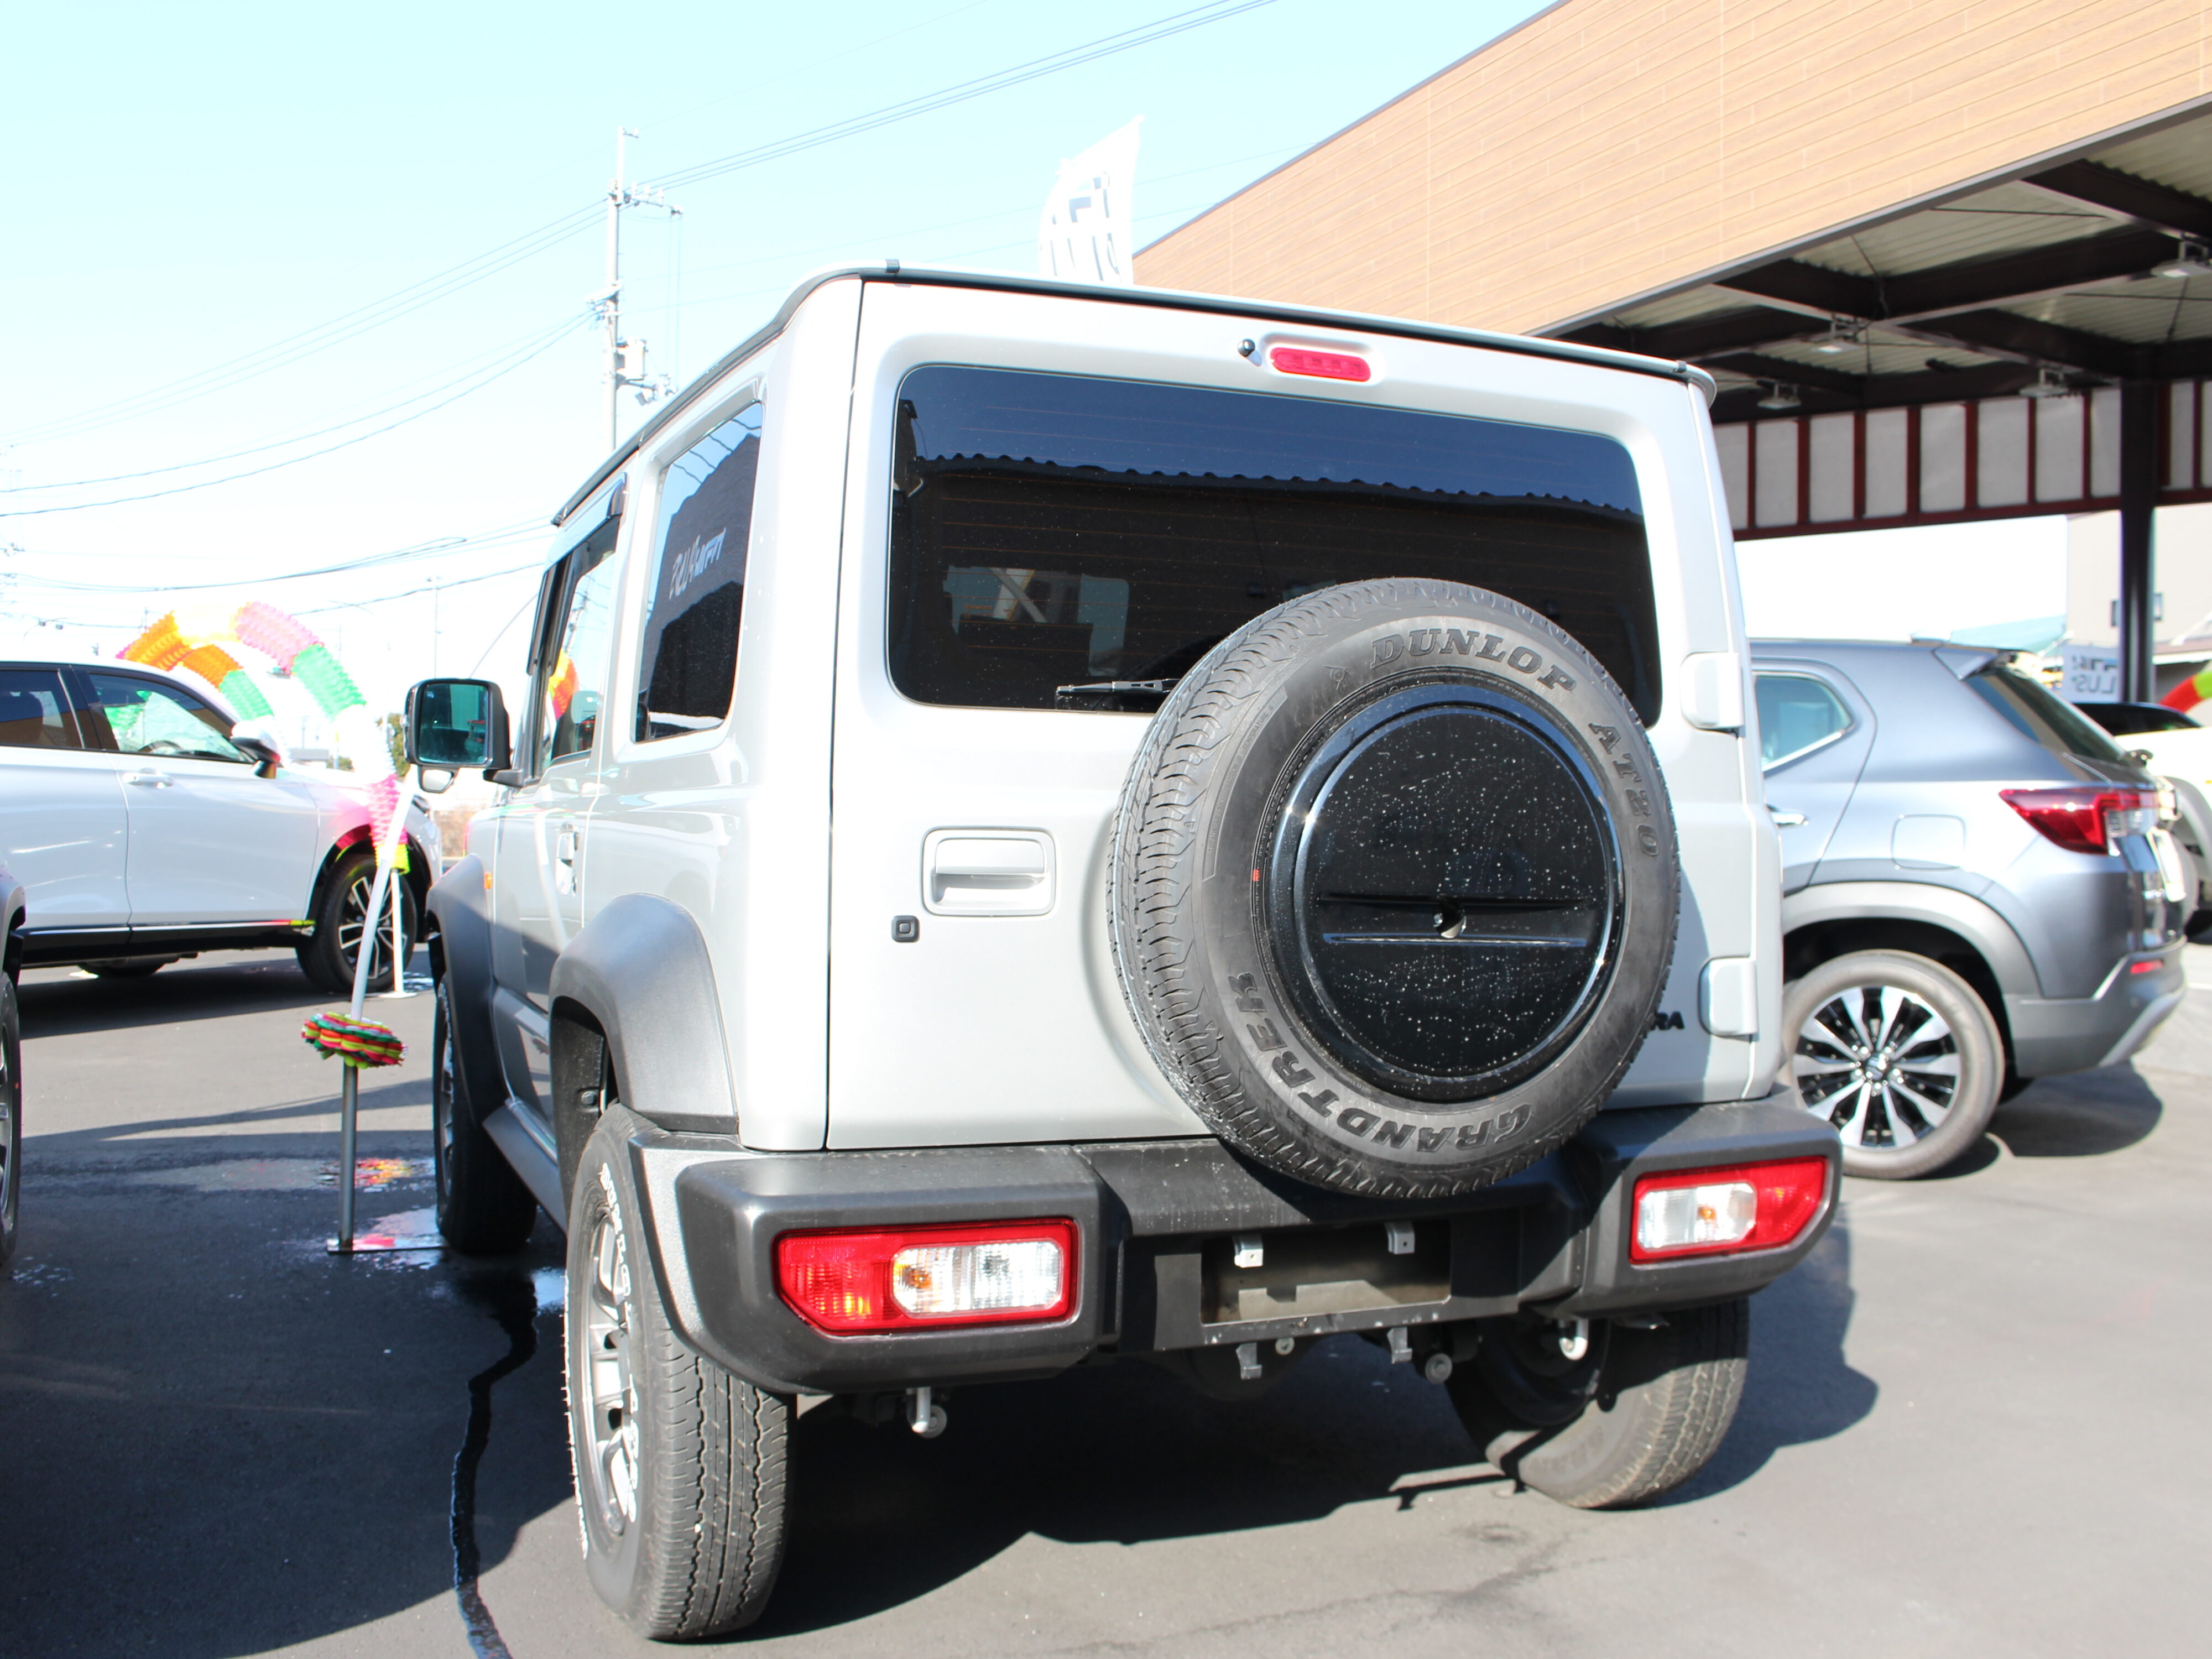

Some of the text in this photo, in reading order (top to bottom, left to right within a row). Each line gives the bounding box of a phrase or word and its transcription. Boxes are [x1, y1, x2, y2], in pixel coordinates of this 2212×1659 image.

[1370, 628, 1660, 858] DUNLOP AT20
[1227, 971, 1532, 1152] GRANDTREK
